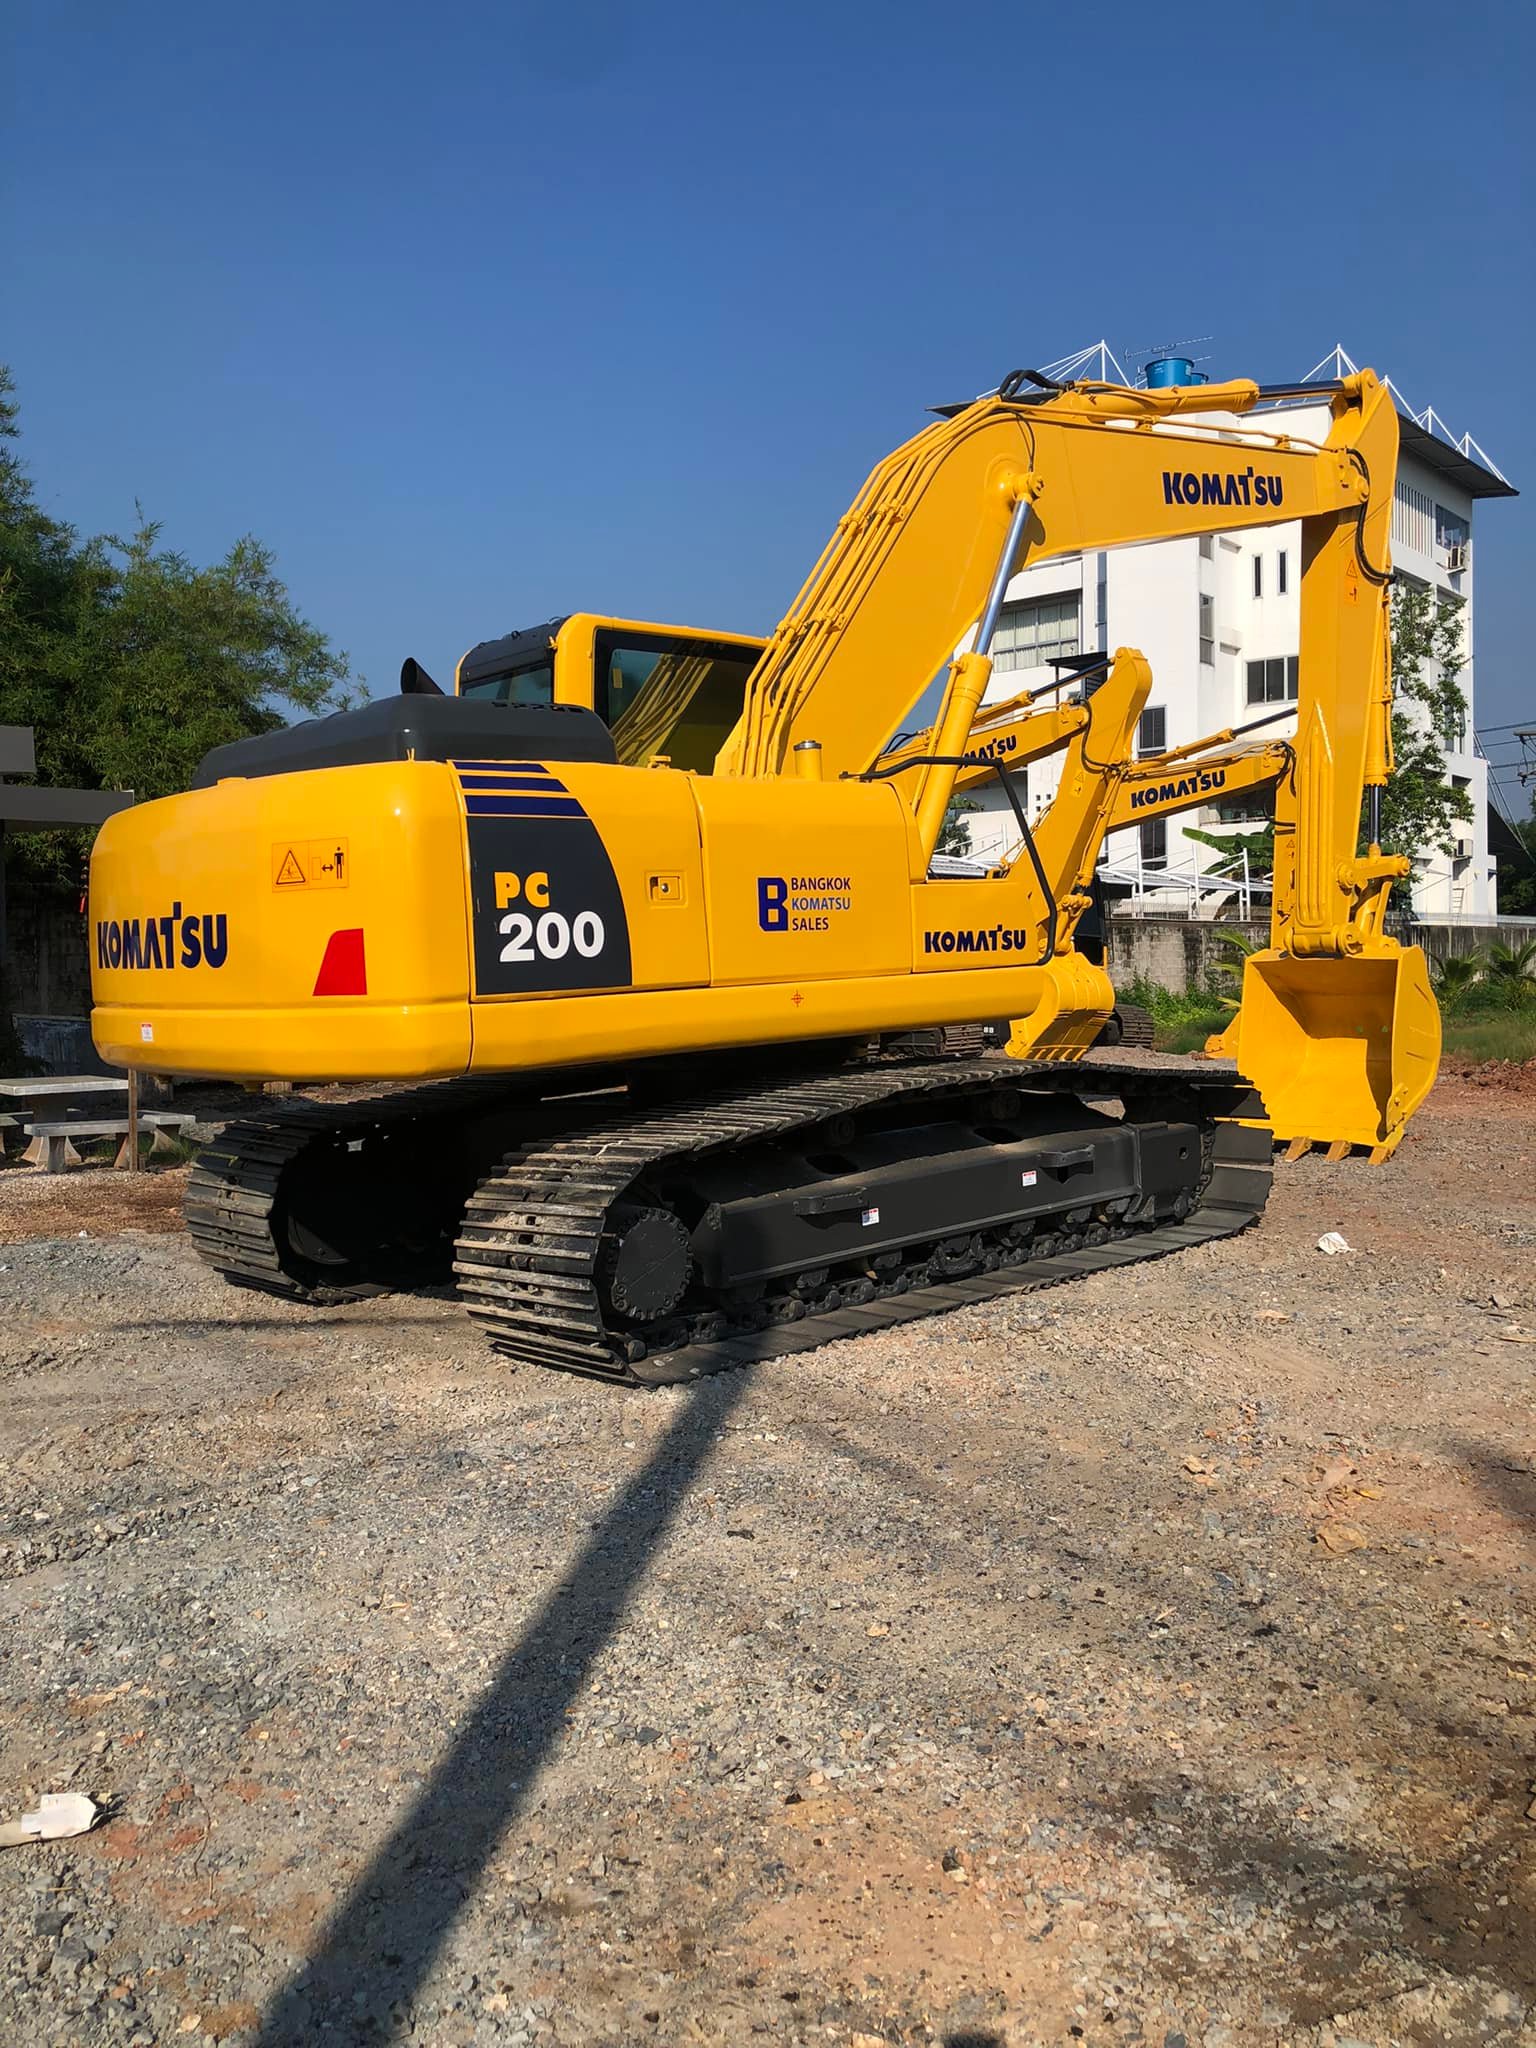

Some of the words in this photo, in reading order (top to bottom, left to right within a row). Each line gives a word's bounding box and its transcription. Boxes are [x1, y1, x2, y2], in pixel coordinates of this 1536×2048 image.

[1162, 466, 1283, 506] KOMATSU
[959, 735, 1016, 768] MATSU
[1131, 769, 1226, 808] KOMATSU
[494, 872, 550, 909] PC
[791, 877, 851, 891] BANGKOK
[791, 897, 851, 911] KOMATSU
[97, 902, 228, 970] KOMATSU
[499, 911, 605, 963] 200
[792, 917, 829, 931] SALES
[924, 925, 1026, 954] KOMATSU
